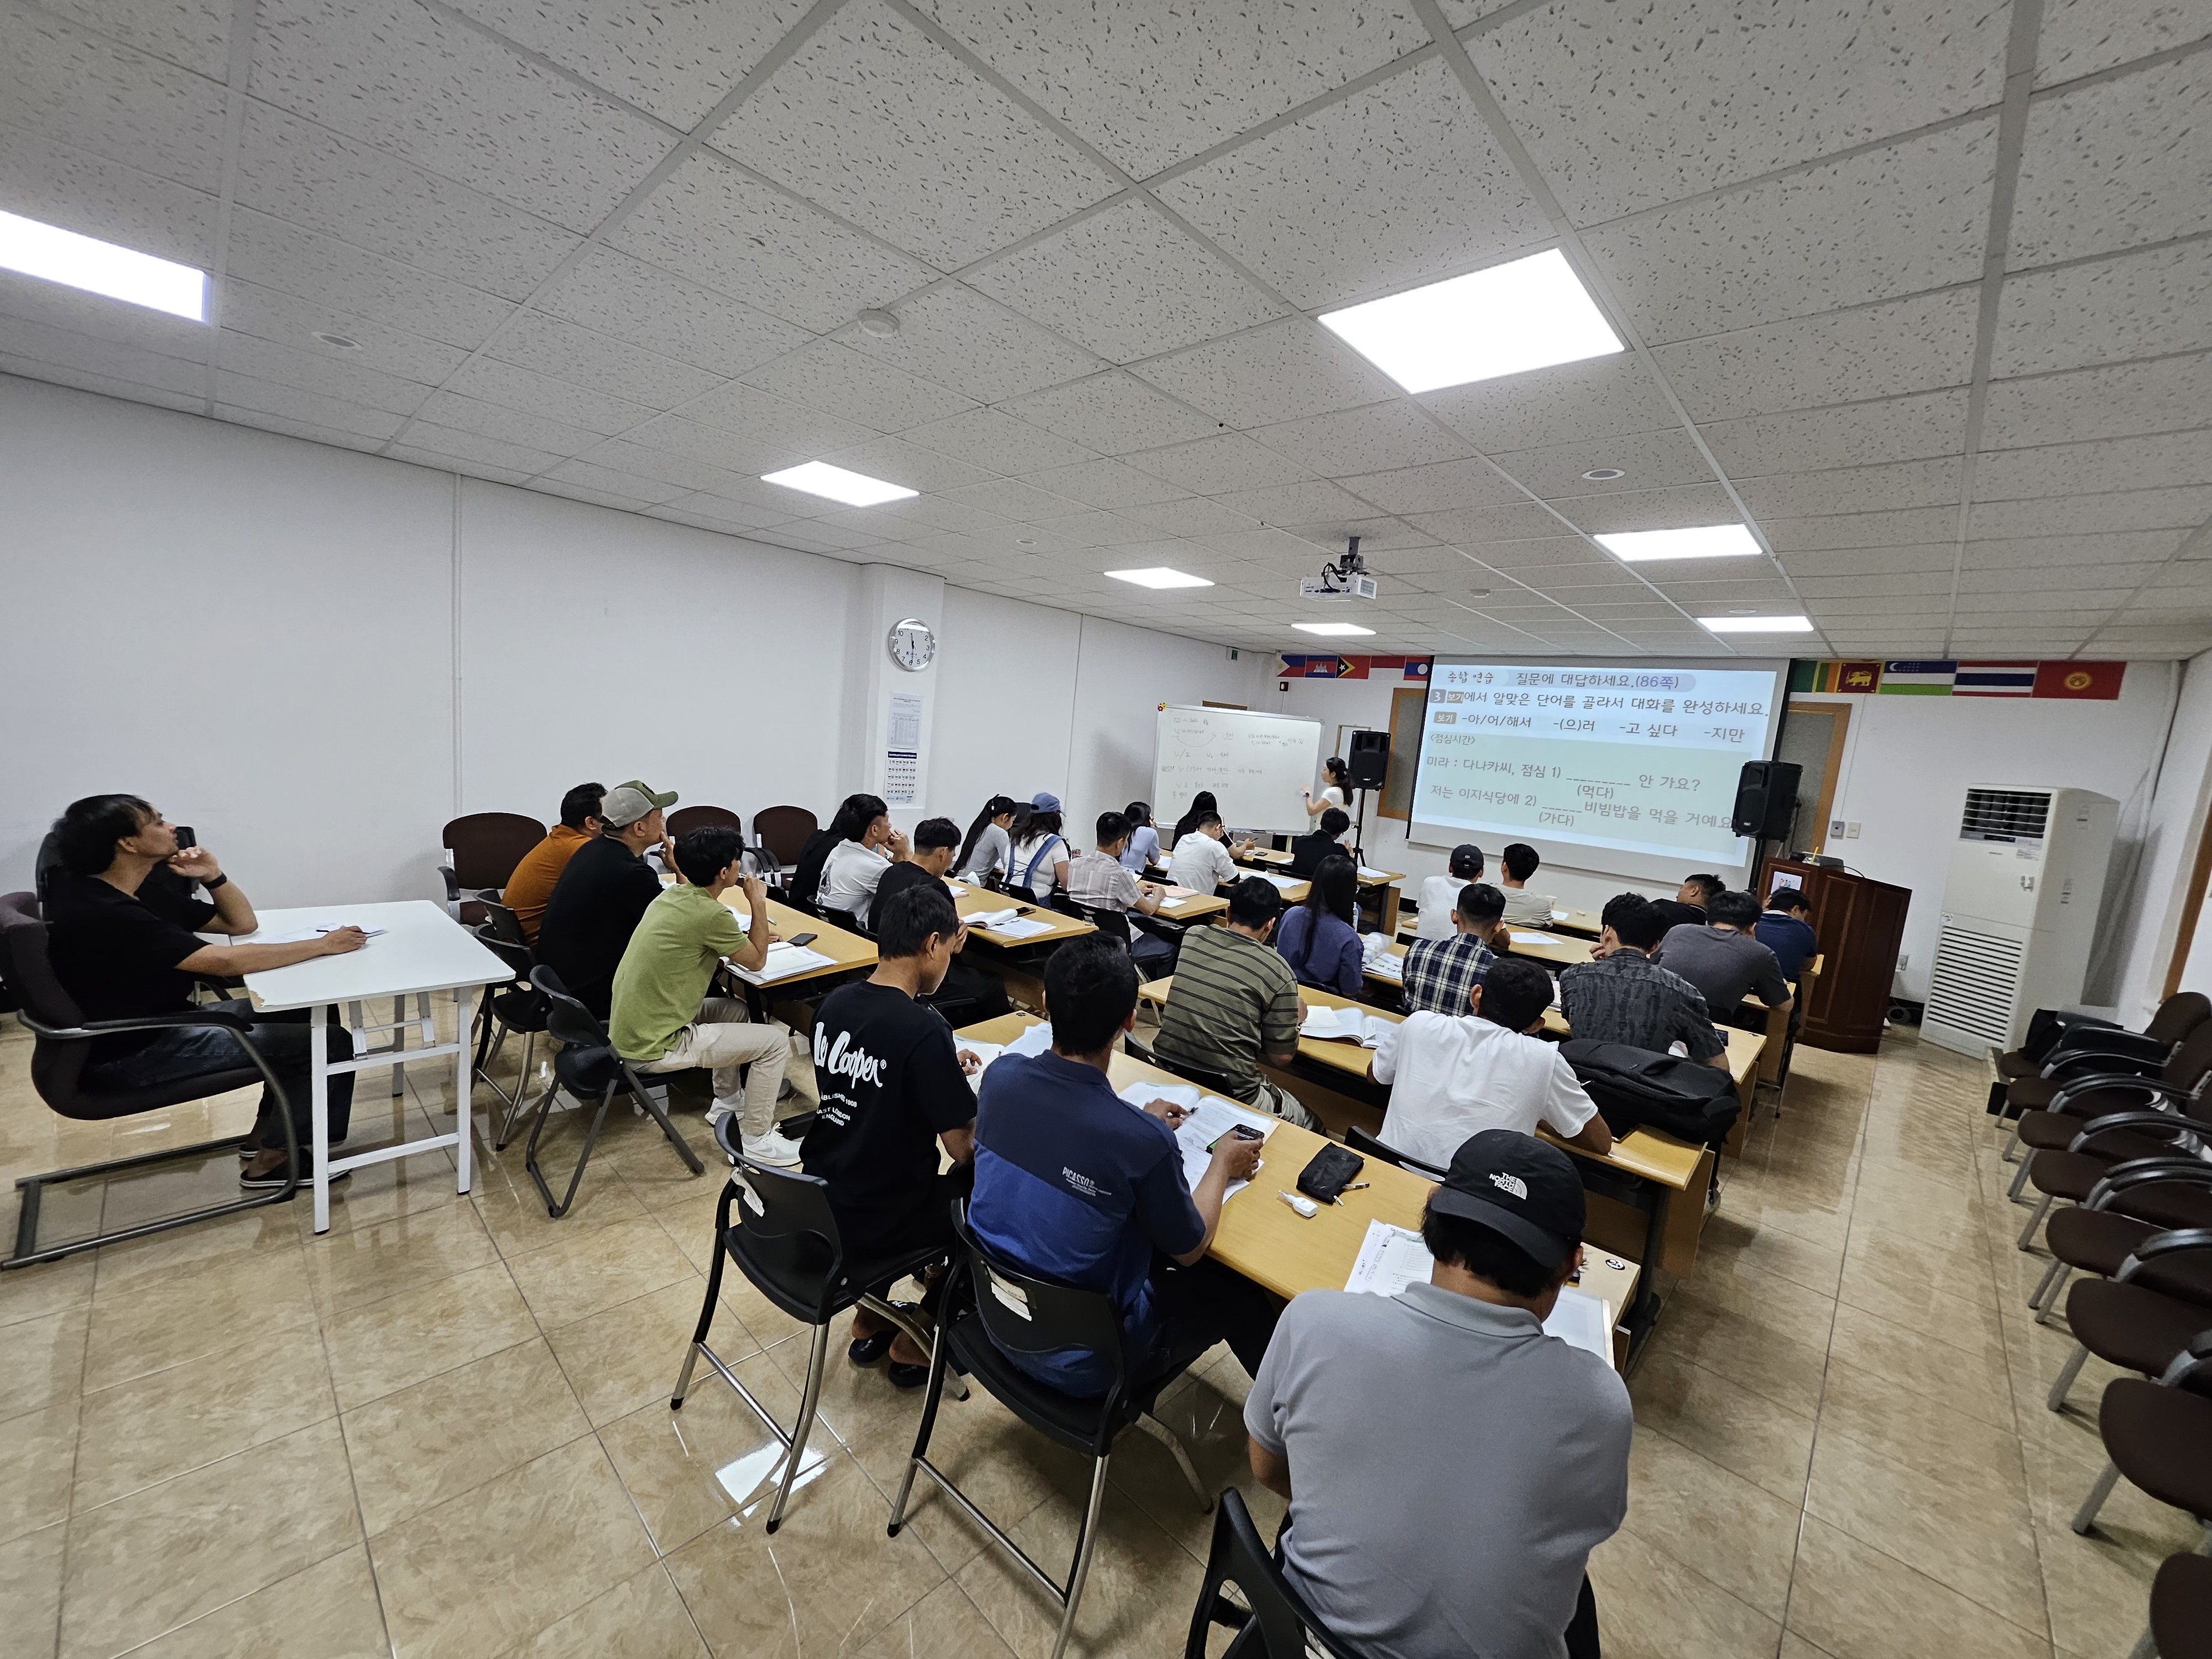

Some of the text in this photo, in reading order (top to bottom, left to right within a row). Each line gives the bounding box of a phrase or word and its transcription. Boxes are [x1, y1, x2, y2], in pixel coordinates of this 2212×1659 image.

[1448, 671, 1469, 683] 종합
[1473, 671, 1494, 684] 연습
[1516, 672, 1554, 686] 질문에
[1434, 691, 1441, 702] 3
[1494, 692, 1530, 706] 알맞은
[1537, 694, 1576, 708] 단어를
[1583, 695, 1624, 709] 골라서
[1631, 697, 1675, 713] 대화를
[1683, 700, 1768, 717] 완성하세요.
[1437, 713, 1453, 723] 보기
[1462, 714, 1531, 728] -아/어/해서
[1553, 718, 1595, 732] -(으)러
[1647, 723, 1678, 738] 싶다
[1704, 727, 1745, 743] -지만
[1427, 756, 1449, 768] 미라
[1463, 758, 1515, 776] 다나카씨,
[1521, 764, 1546, 779] 점심
[1551, 766, 1561, 779] 1)
[1639, 774, 1654, 789] 안
[1659, 776, 1701, 792] 가요?
[1577, 784, 1614, 800] (먹다)
[1431, 784, 1453, 799] 저는
[1459, 787, 1520, 805] 이지식당에
[1525, 795, 1537, 807] 2)
[1584, 801, 1641, 821] 비빔밥을
[1649, 808, 1678, 825] 먹을
[1538, 811, 1574, 827] (가다)
[828, 1030, 883, 1089] Cooper
[1489, 1173, 1516, 1188] NORTH
[1502, 1172, 1517, 1183] THE
[1494, 1181, 1514, 1193] FACE
